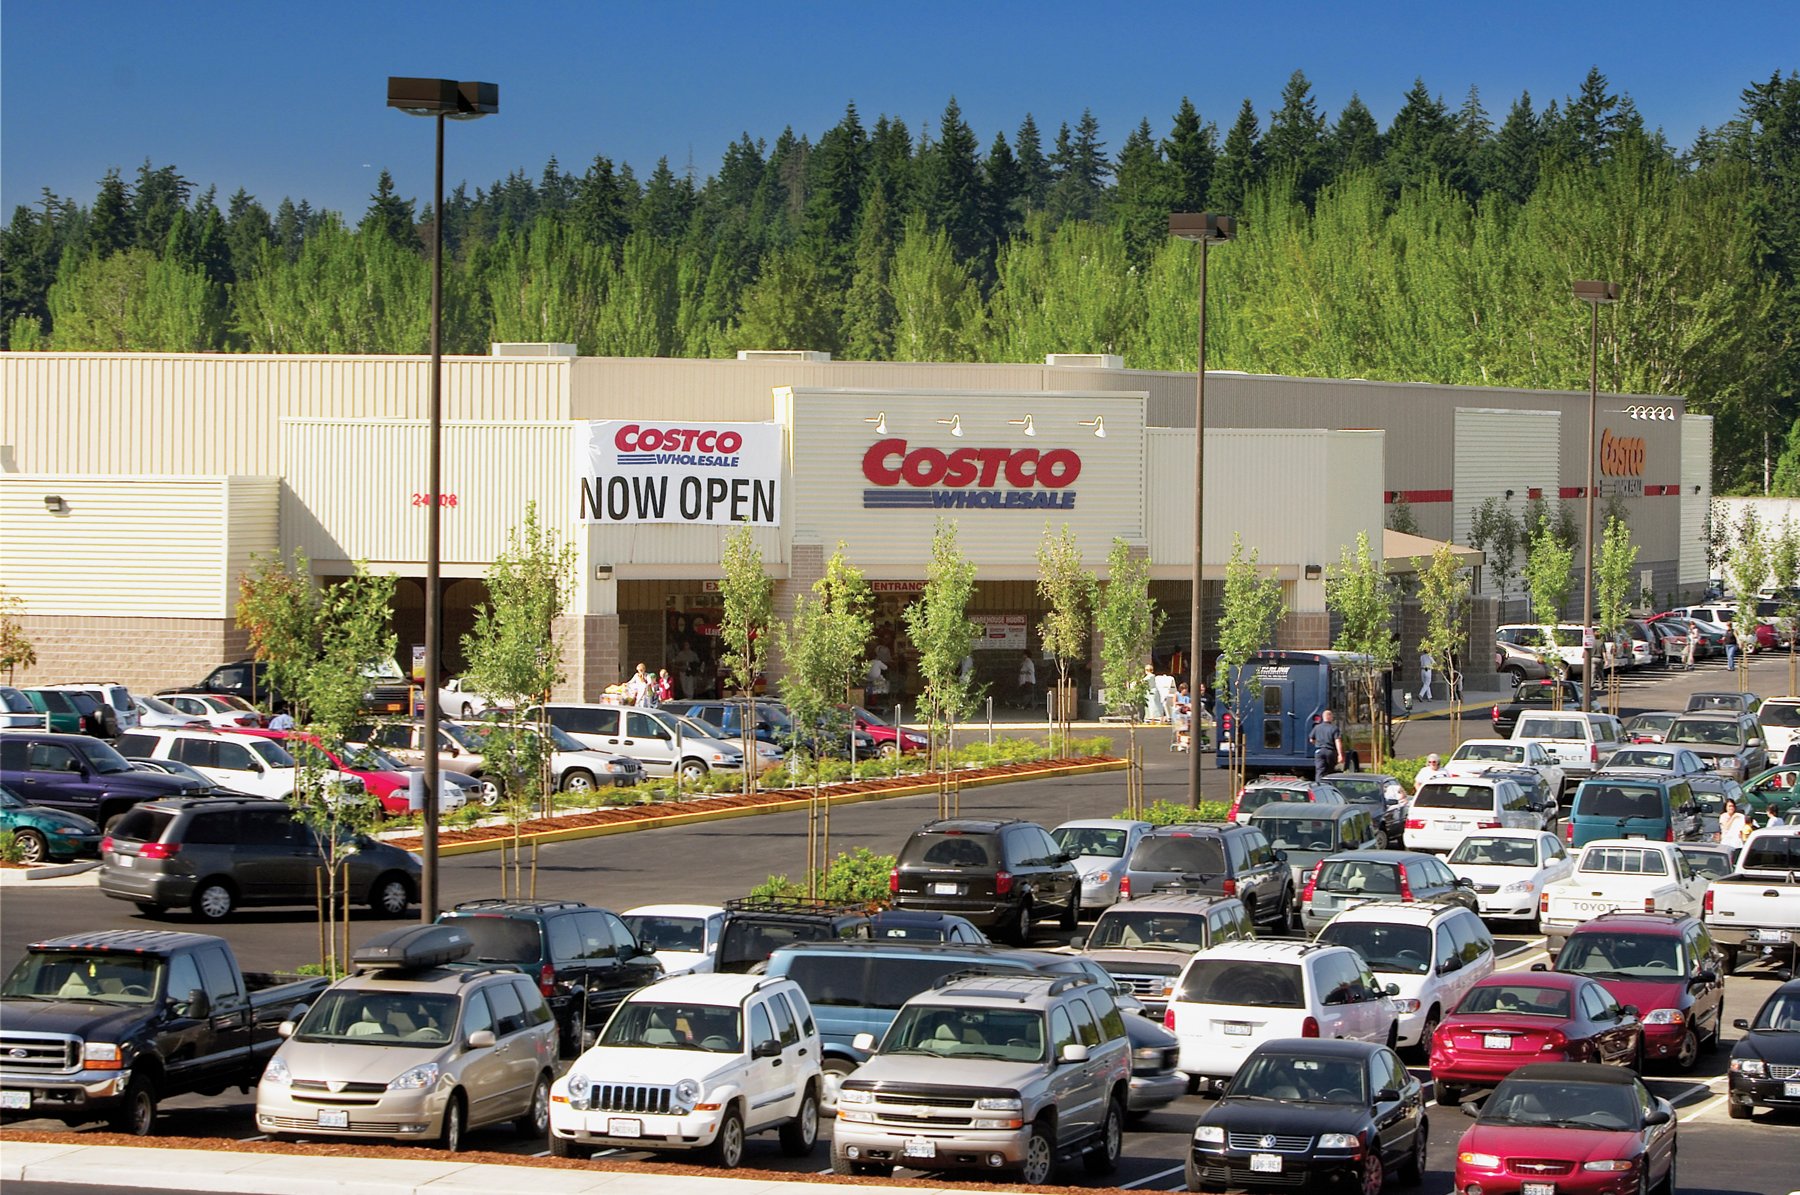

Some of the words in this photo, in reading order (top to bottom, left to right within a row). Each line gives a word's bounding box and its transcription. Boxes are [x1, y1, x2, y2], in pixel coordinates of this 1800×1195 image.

[614, 424, 743, 454] COSTCO
[1600, 428, 1646, 477] COSTCO
[655, 453, 739, 467] WHOLESALE
[862, 438, 1081, 488] COSTCO
[412, 493, 457, 507] 2408
[580, 476, 668, 520] NOW
[680, 476, 775, 522] OPEN
[931, 490, 1076, 509] WHOLESALE
